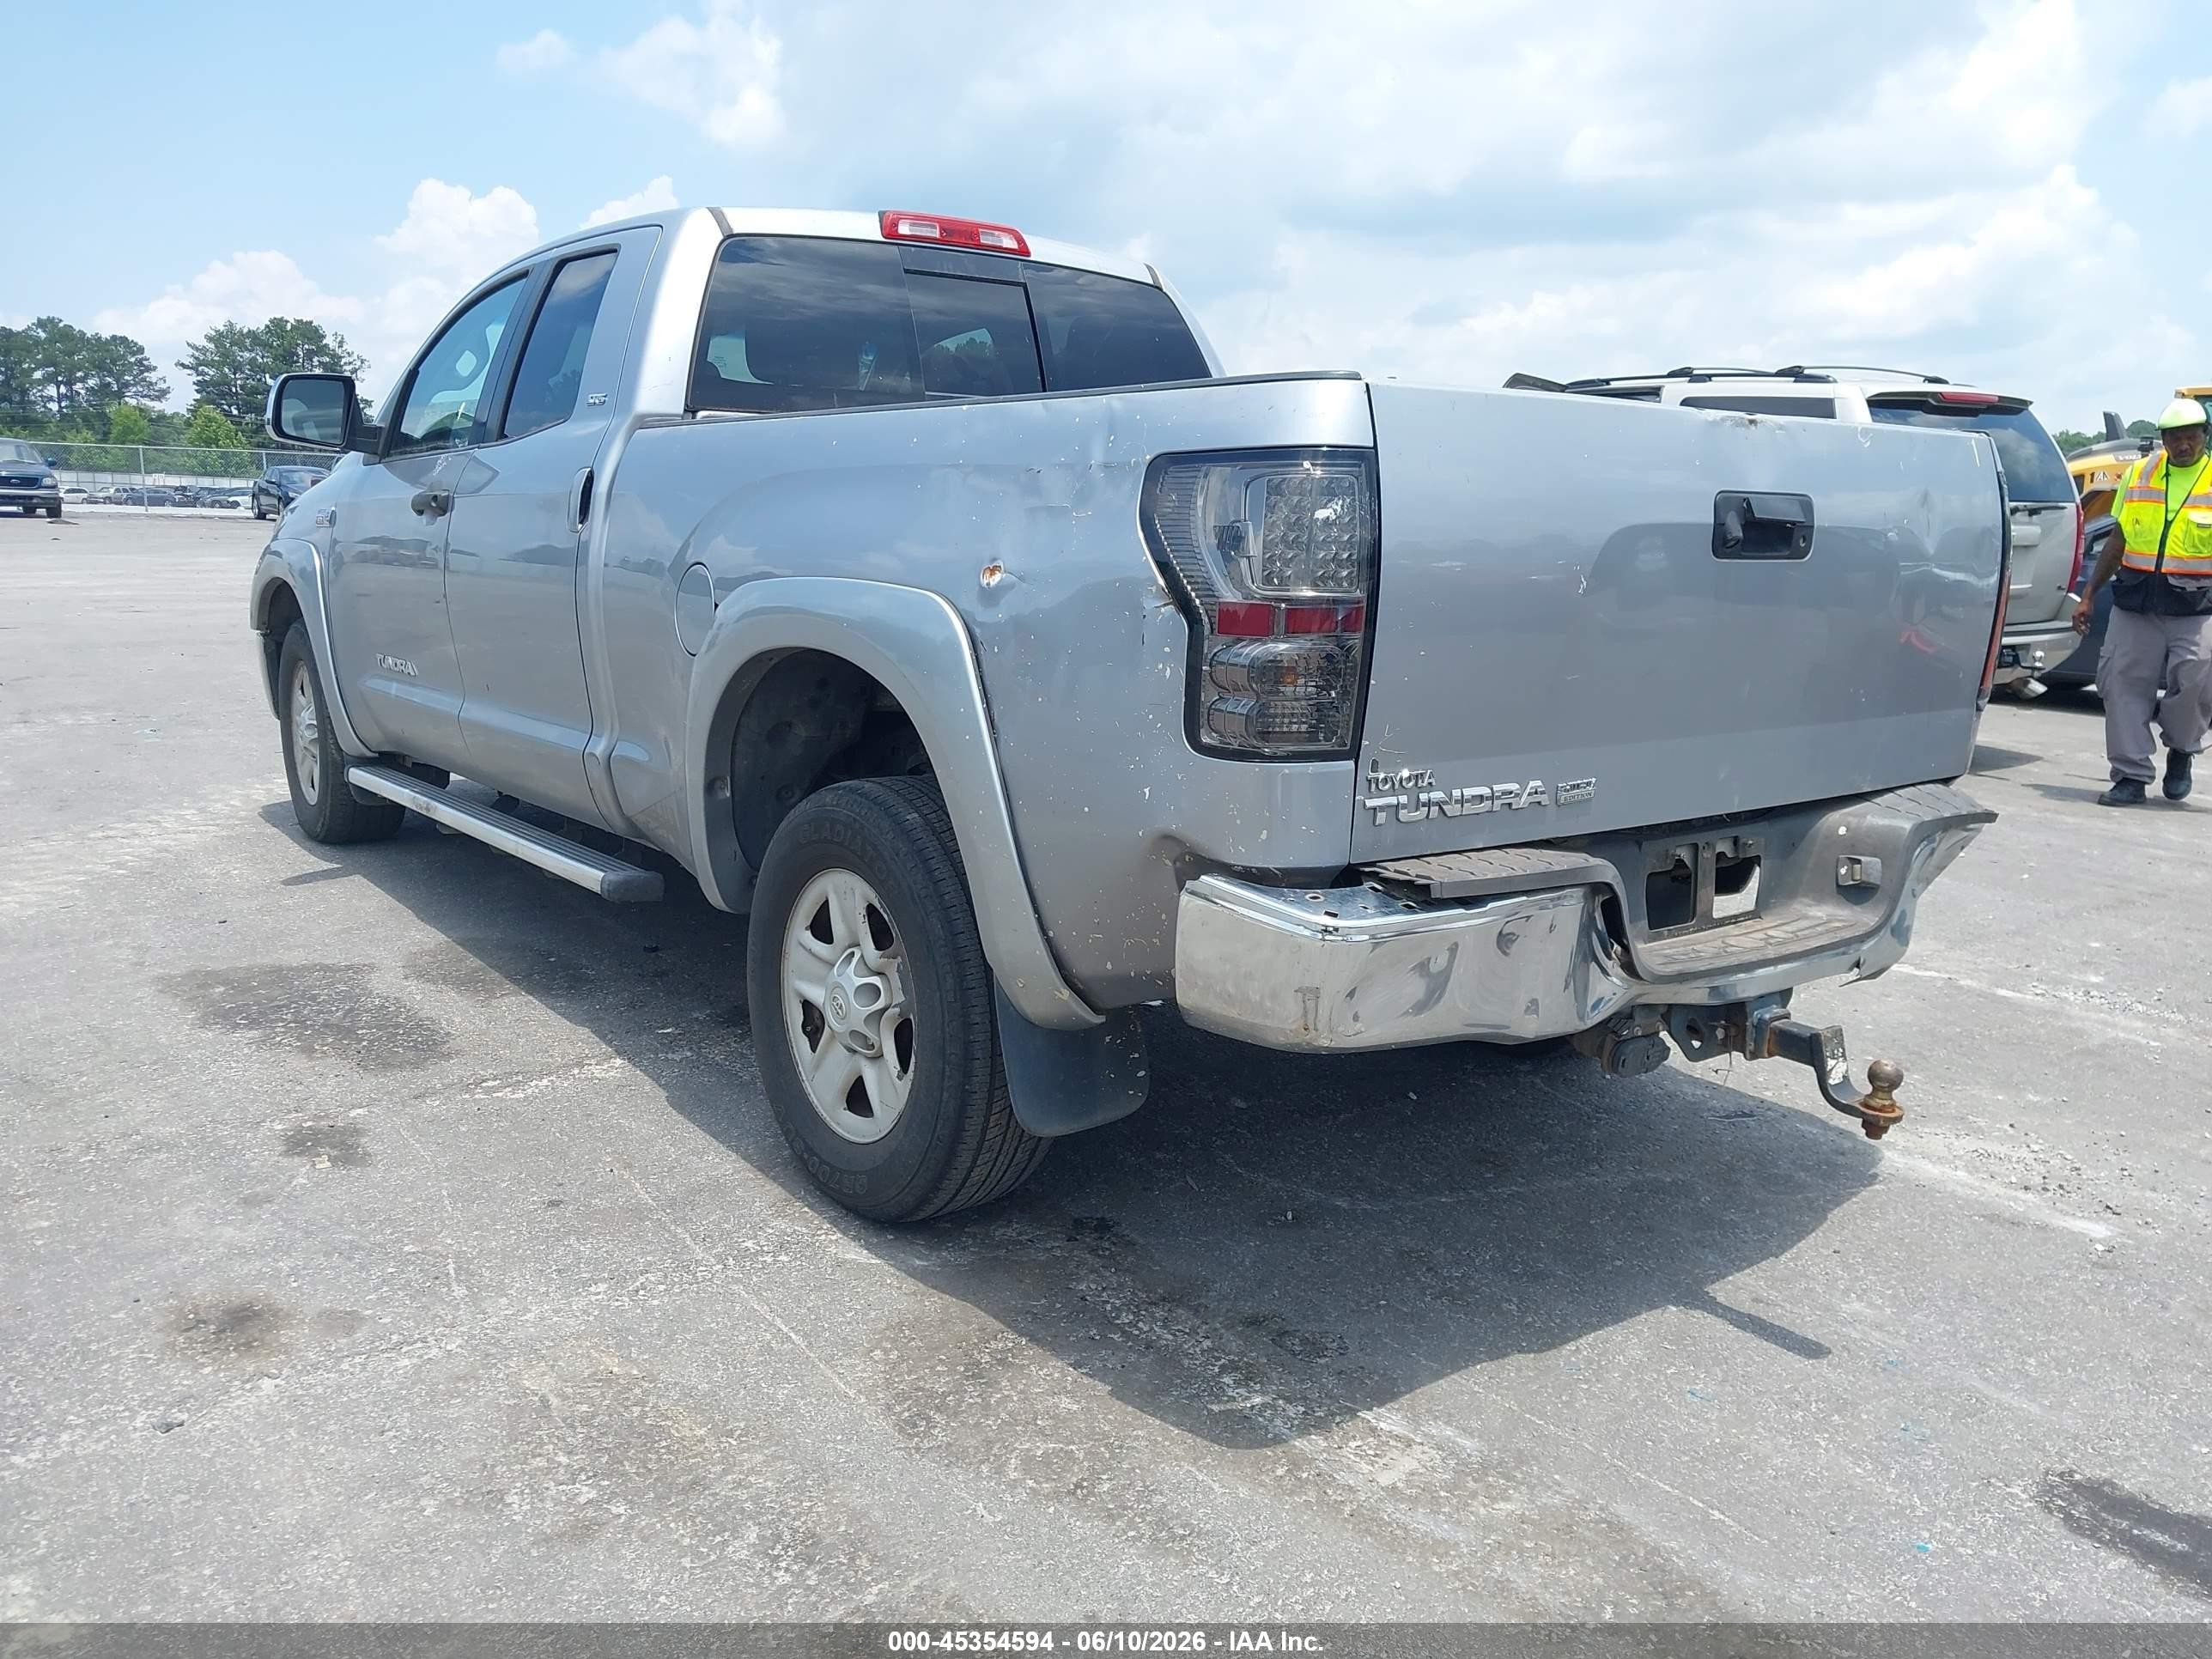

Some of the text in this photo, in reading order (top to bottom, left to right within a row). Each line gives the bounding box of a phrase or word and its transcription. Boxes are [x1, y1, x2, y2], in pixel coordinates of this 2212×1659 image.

[375, 653, 419, 676] TUNDRA
[1367, 768, 1437, 792] TOYOTA
[1364, 780, 1549, 826] TUNDRA
